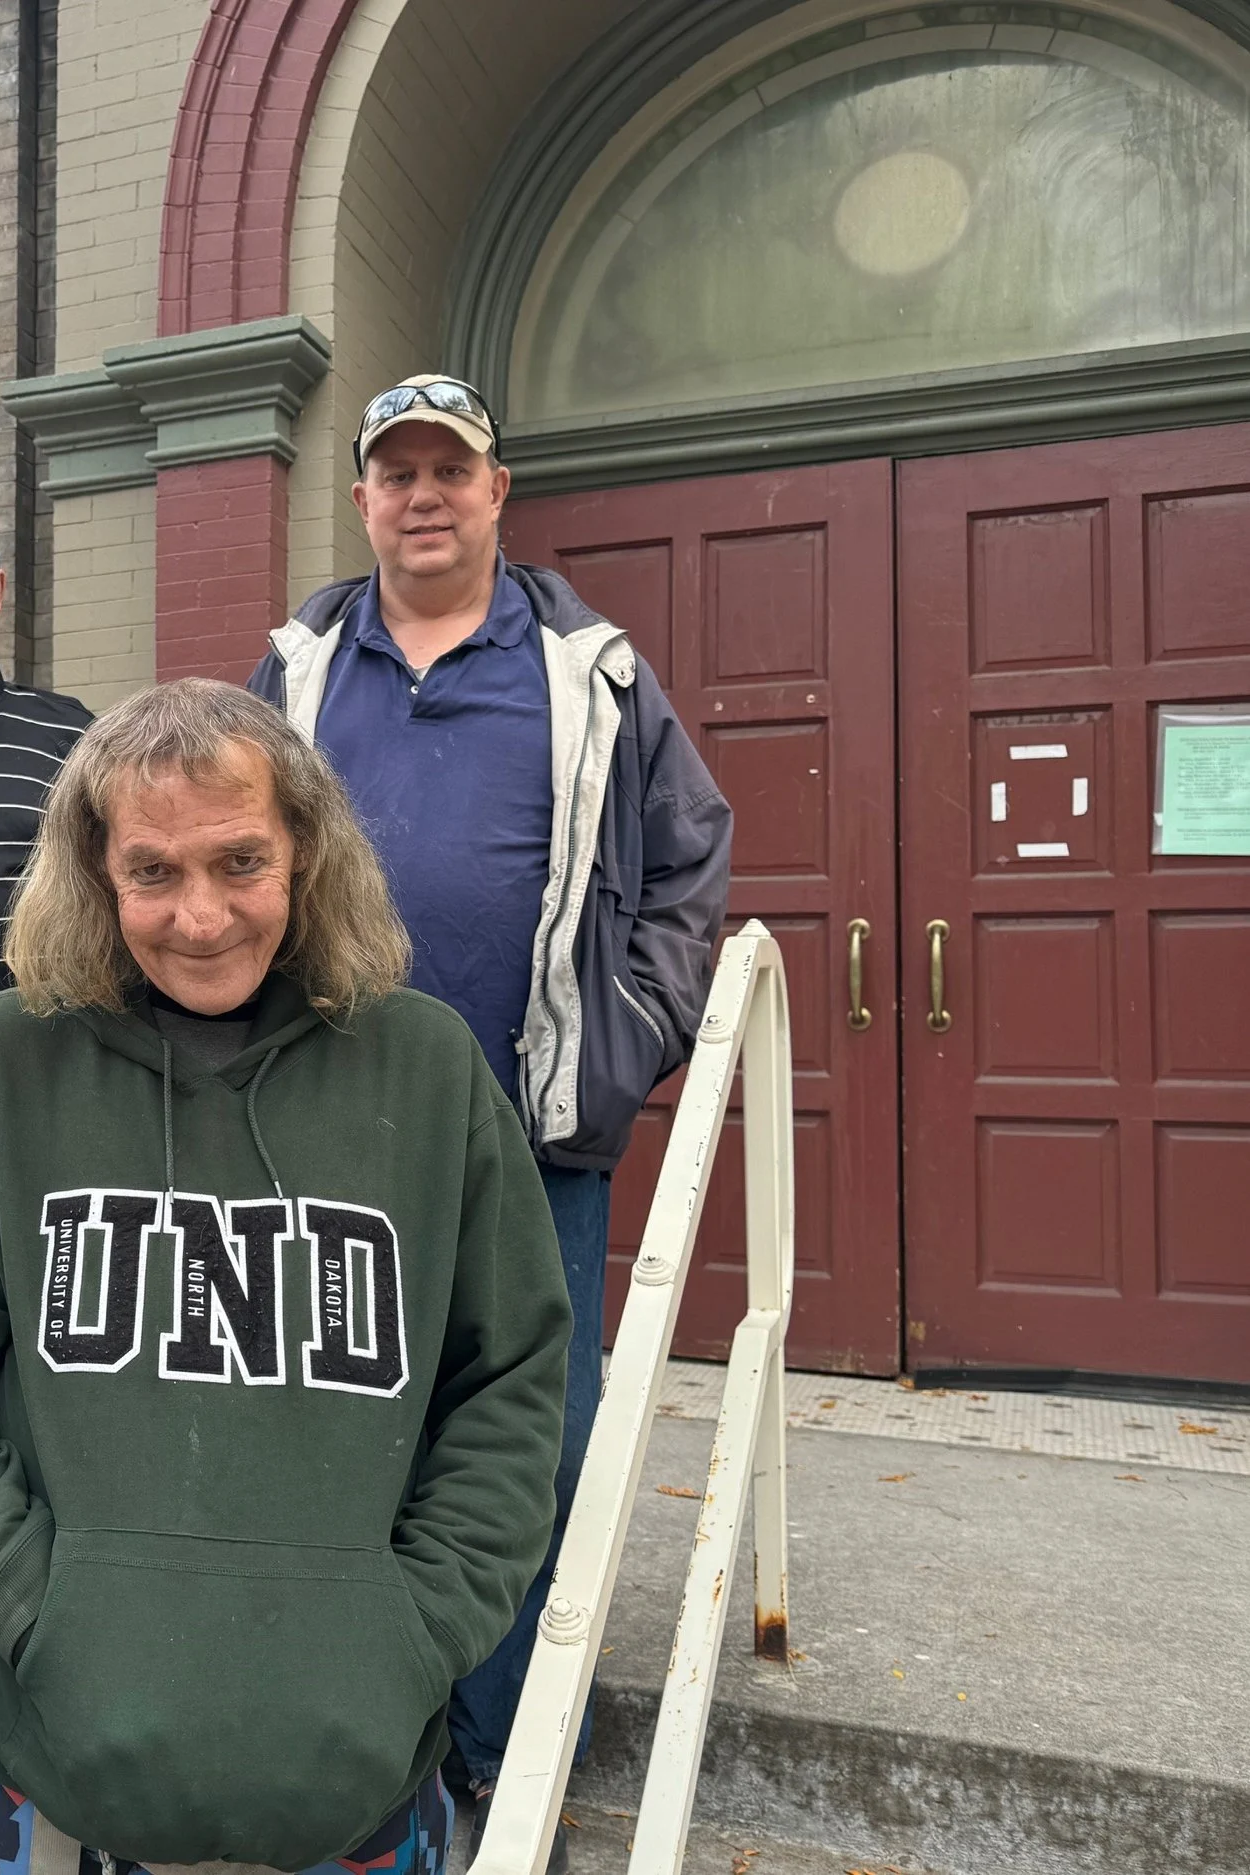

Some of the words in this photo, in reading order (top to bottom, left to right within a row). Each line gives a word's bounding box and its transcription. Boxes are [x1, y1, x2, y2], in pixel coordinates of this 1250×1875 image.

[37, 1187, 410, 1399] UND
[51, 1218, 73, 1309] UNIVERSITY
[187, 1258, 206, 1317] NORTH
[324, 1258, 343, 1327] DAKOTA
[49, 1319, 64, 1340] OF
